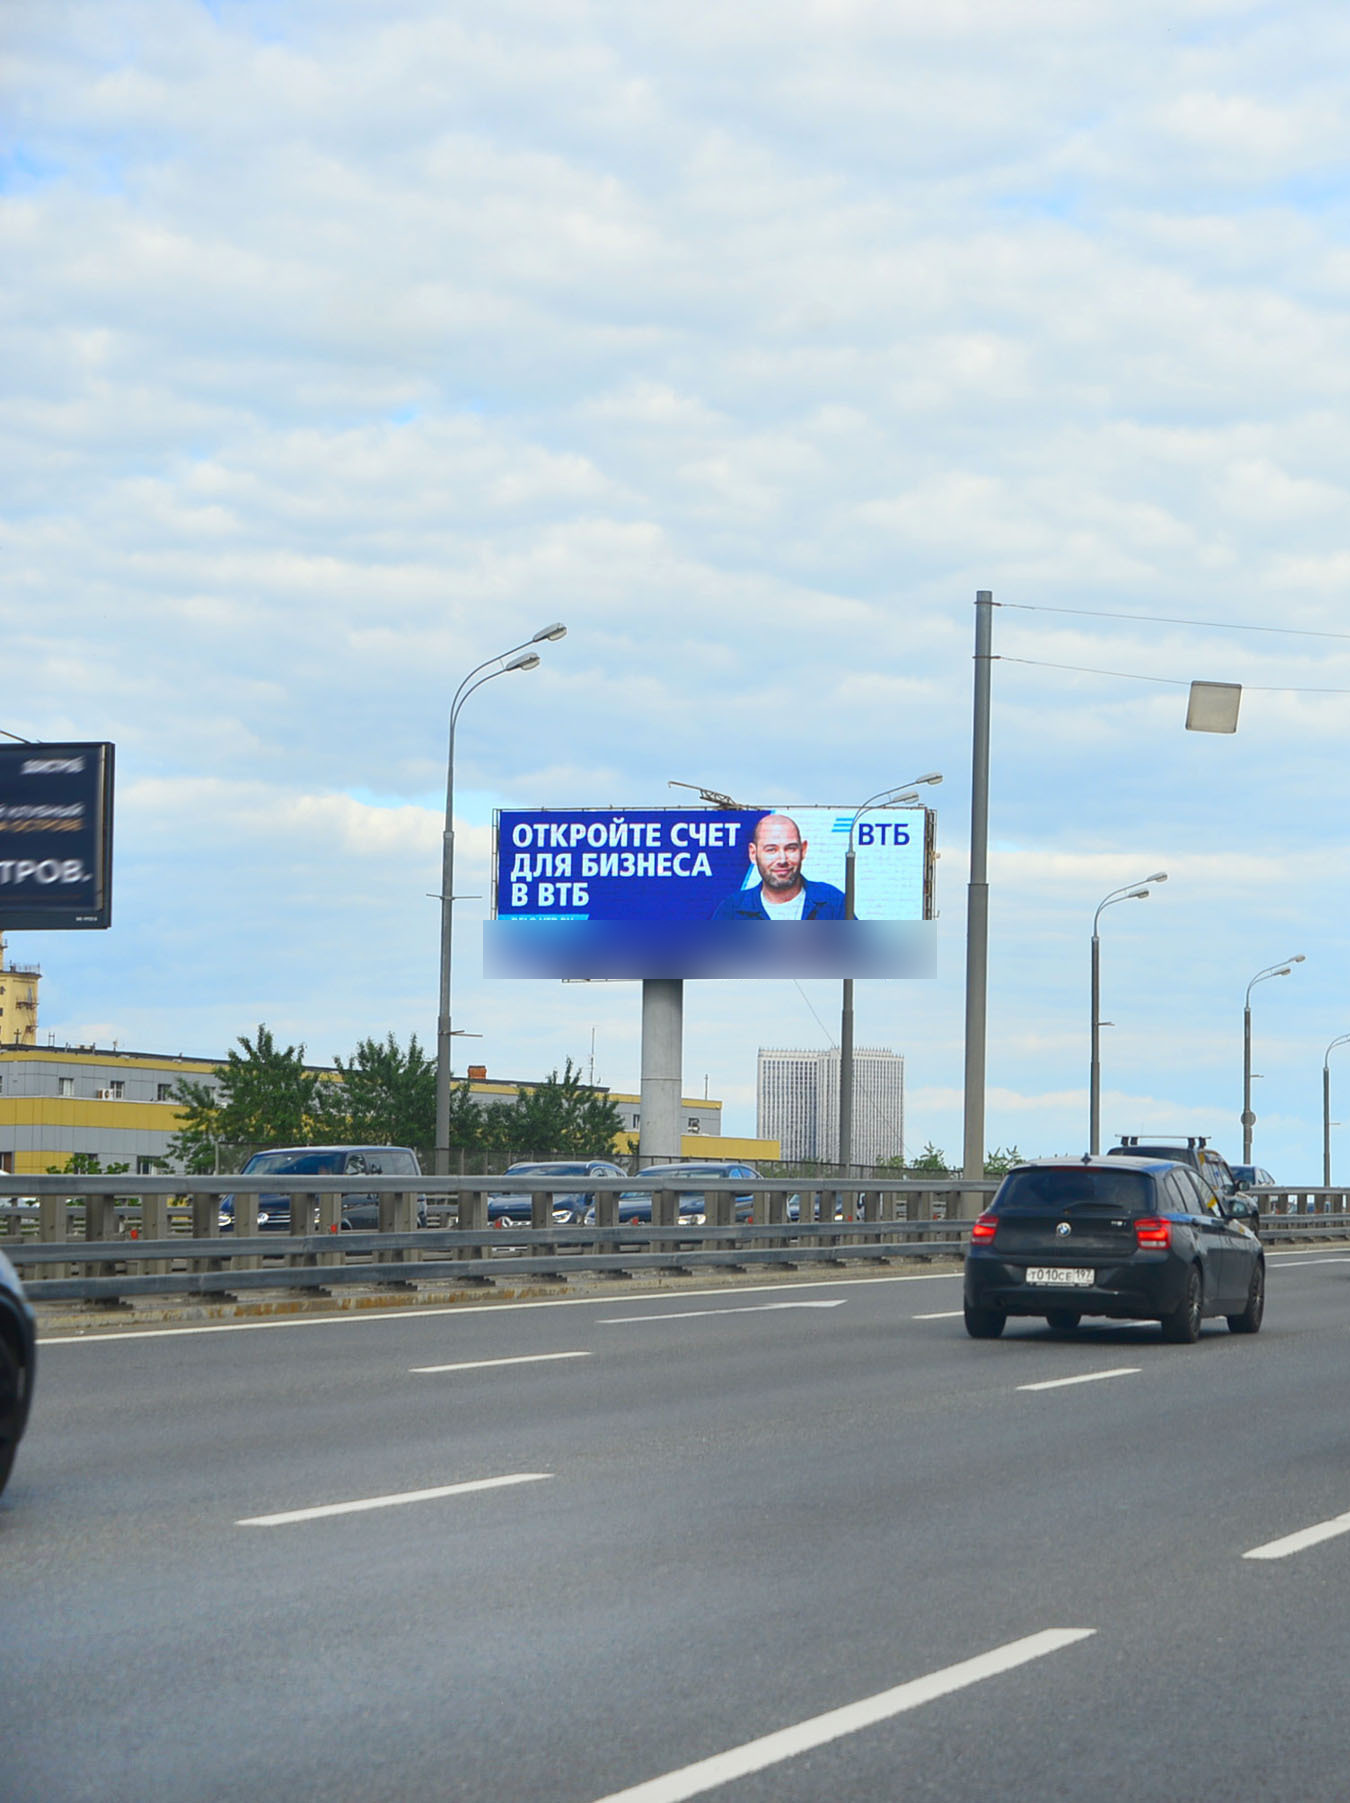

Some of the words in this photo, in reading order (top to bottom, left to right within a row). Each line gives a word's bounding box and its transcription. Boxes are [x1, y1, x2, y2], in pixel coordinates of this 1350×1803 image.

[511, 817, 662, 848] ОТКРОЙТЕ
[671, 822, 741, 847] СЧЕТ
[858, 823, 910, 846] ВТБ
[510, 853, 572, 881] ДЛЯ
[581, 852, 713, 877] БИЗНЕСА
[511, 882, 528, 907] В
[537, 882, 590, 907] ВТБ
